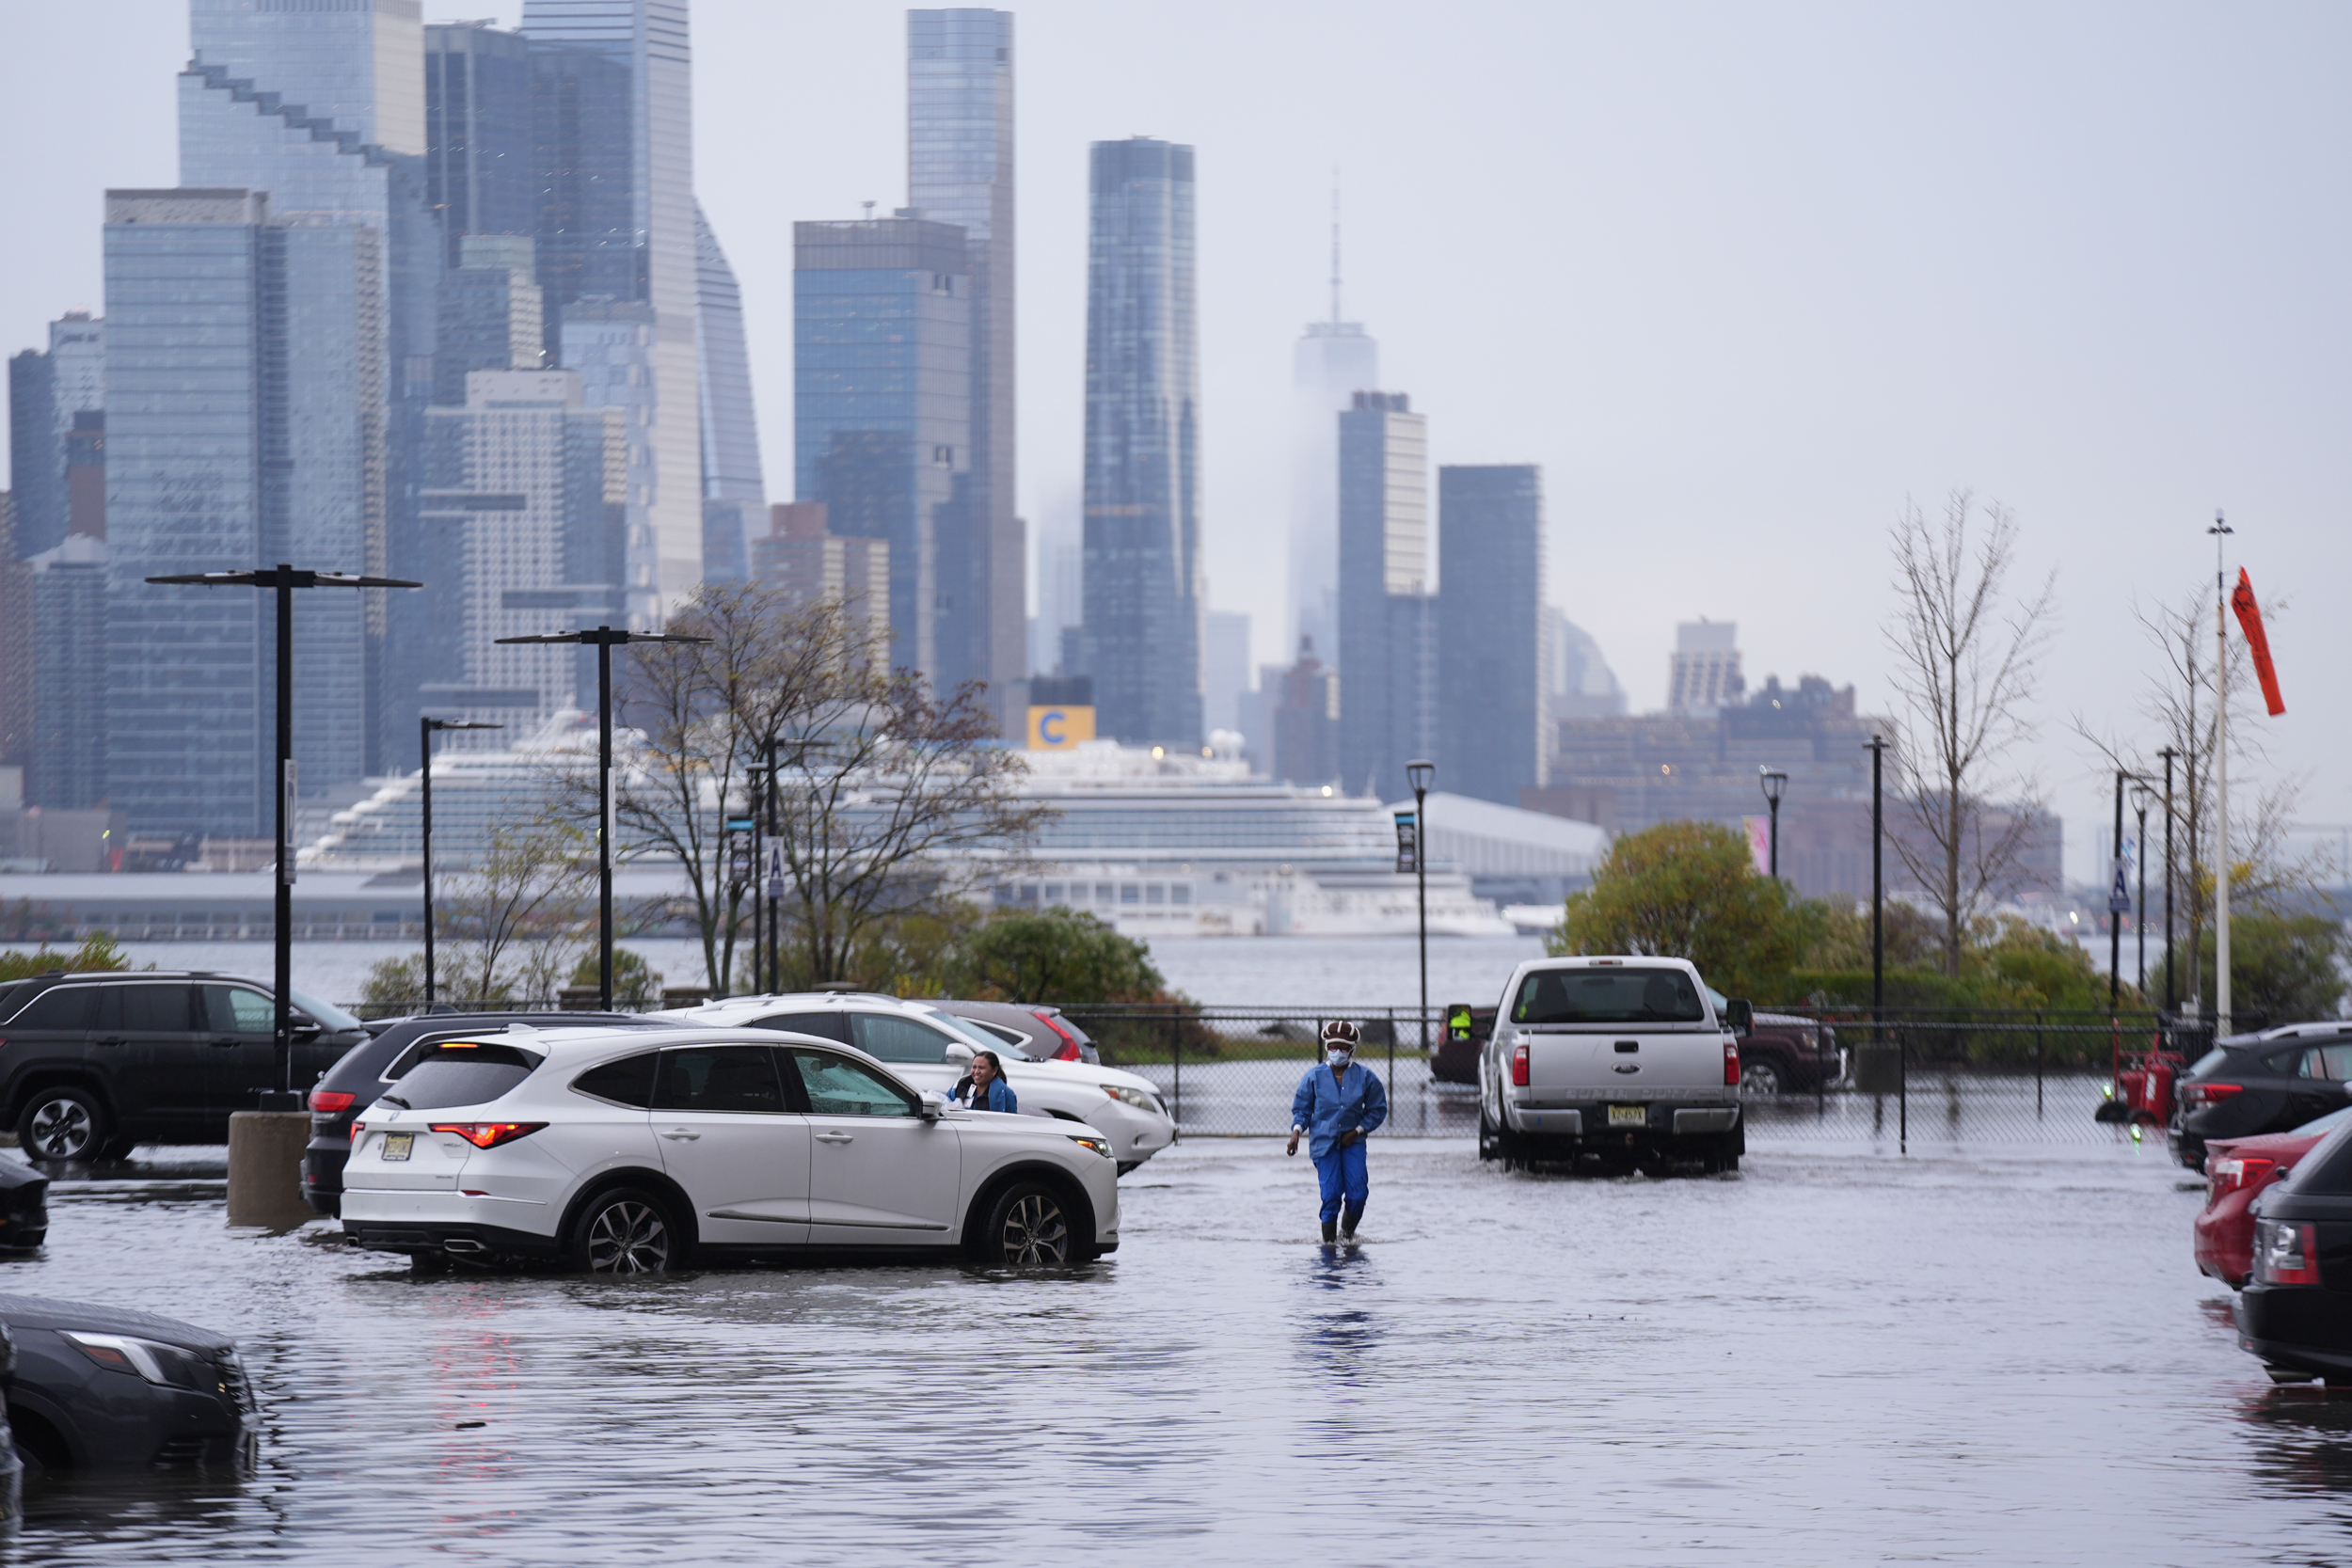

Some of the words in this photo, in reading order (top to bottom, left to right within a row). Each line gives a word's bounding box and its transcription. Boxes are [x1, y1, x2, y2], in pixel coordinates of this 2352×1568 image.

[1041, 712, 1065, 744] C
[771, 847, 782, 877] A
[2113, 868, 2126, 896] A
[1565, 1088, 1628, 1099] SUPER
[1641, 1088, 1690, 1099] DUTY
